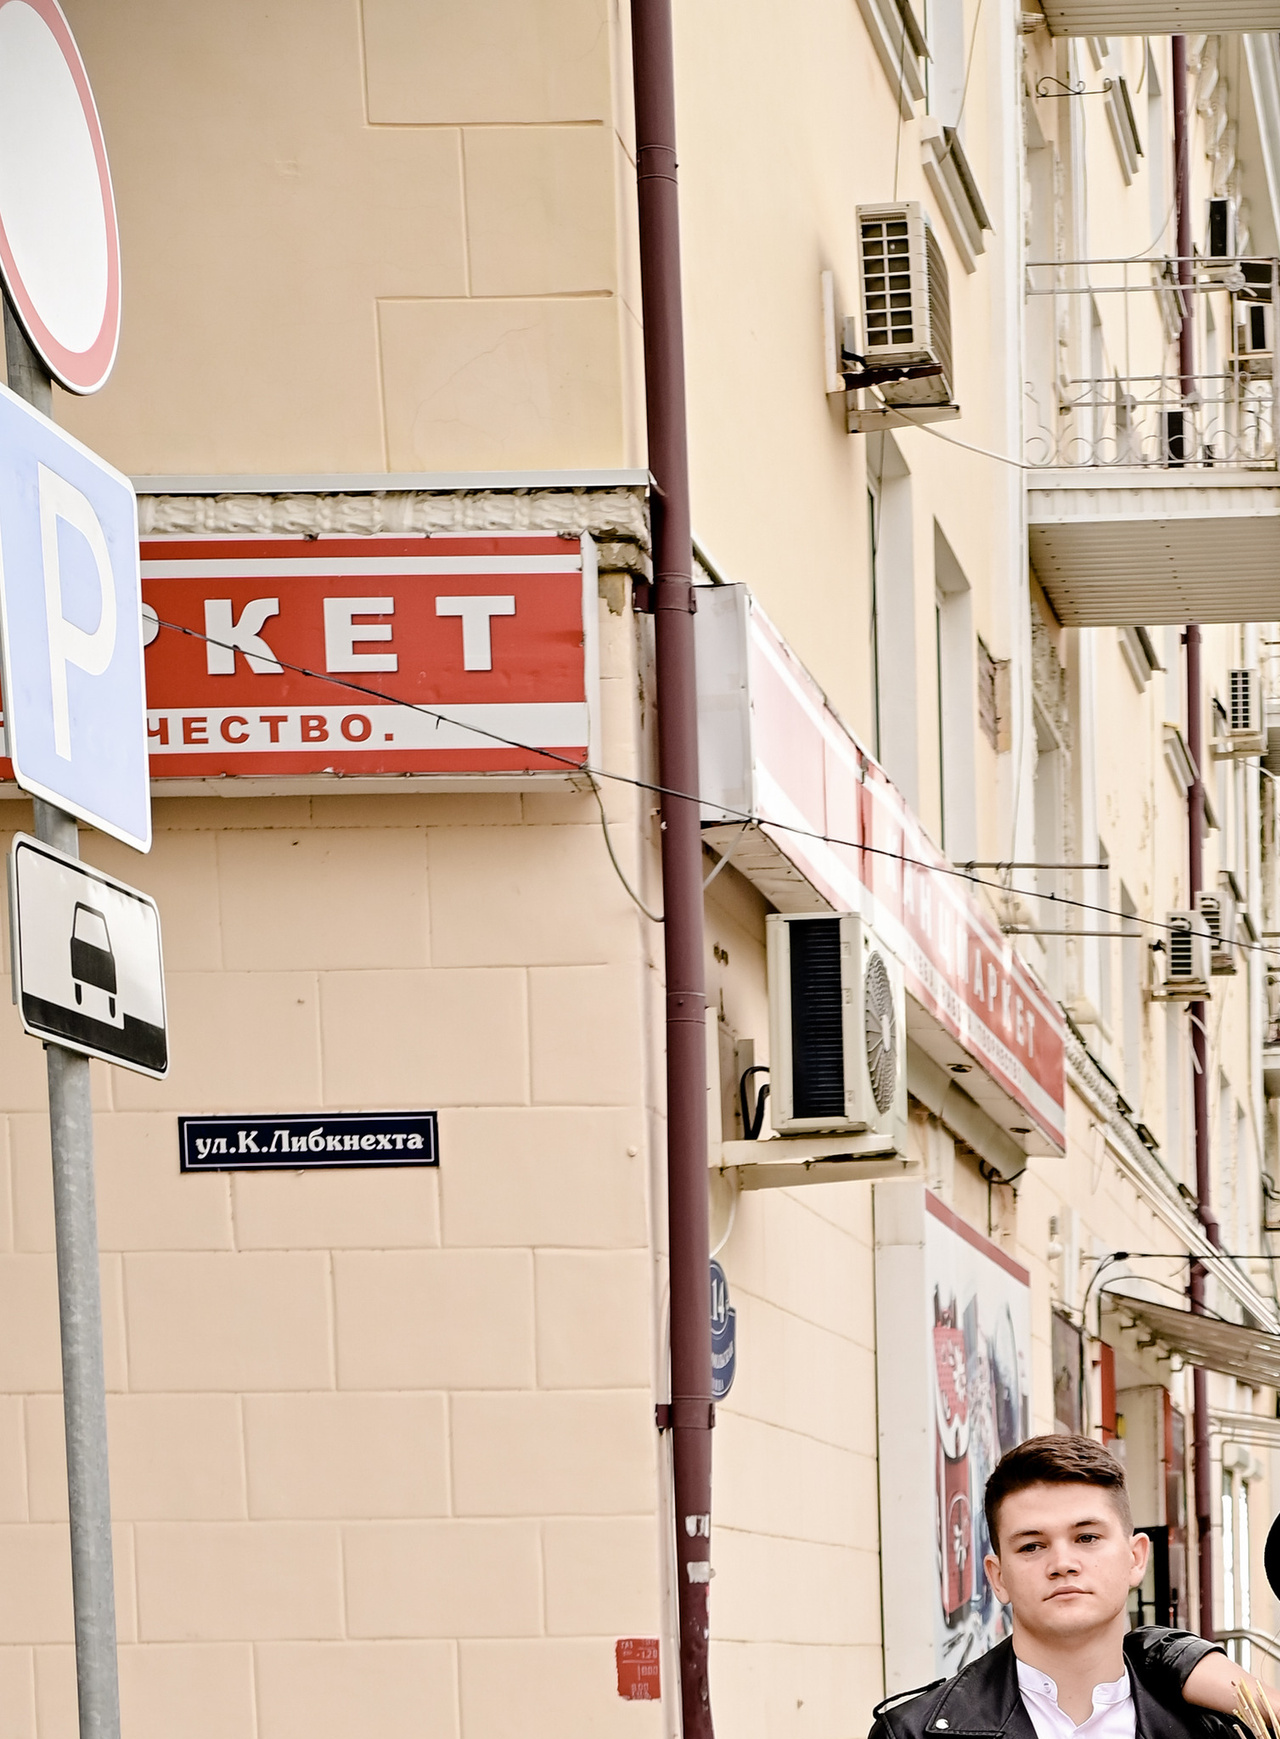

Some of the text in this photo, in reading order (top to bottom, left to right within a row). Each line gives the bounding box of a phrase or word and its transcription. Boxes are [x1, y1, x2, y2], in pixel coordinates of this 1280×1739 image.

[38, 461, 117, 763] P
[143, 595, 516, 675] КЕТ
[195, 1126, 425, 1160] ул.К.Либкнехта
[711, 1278, 725, 1324] 14
